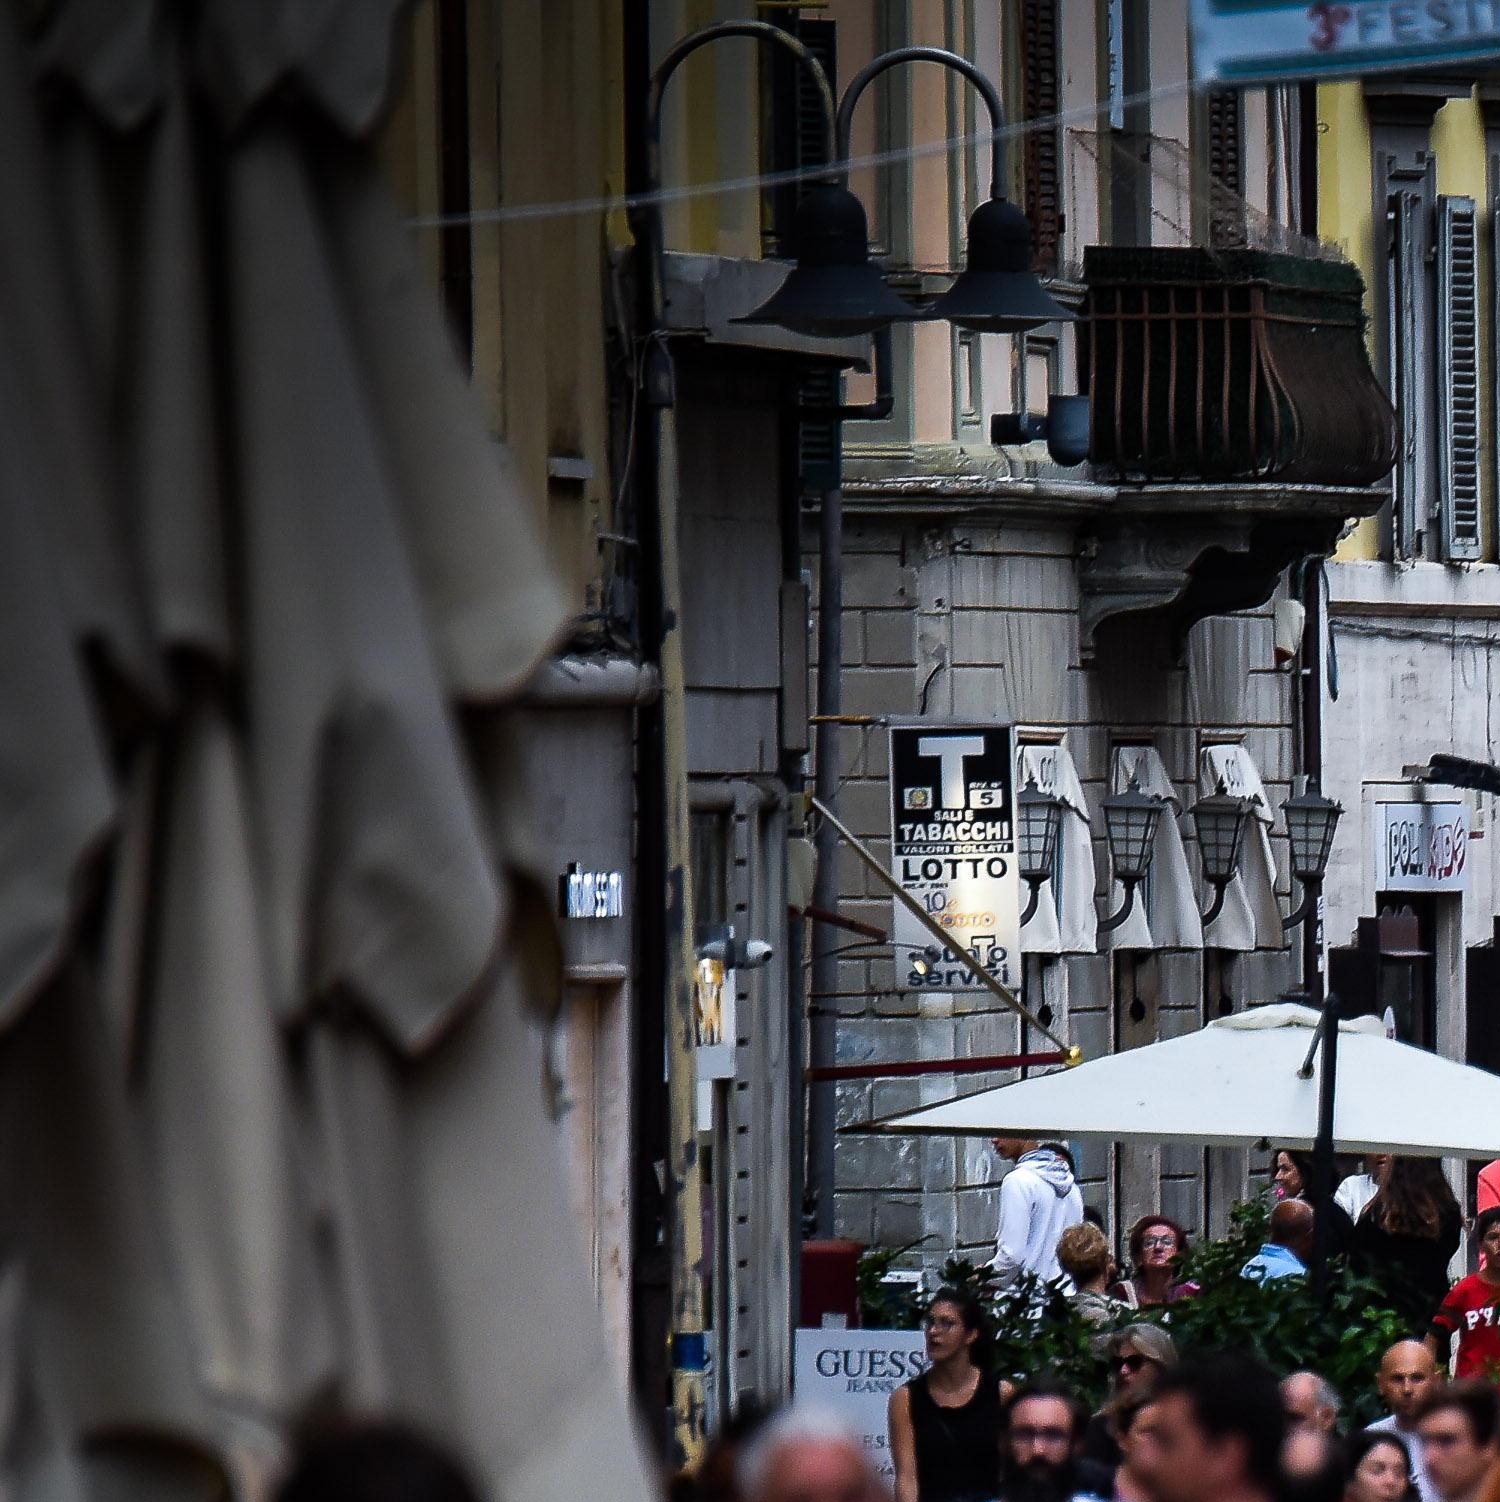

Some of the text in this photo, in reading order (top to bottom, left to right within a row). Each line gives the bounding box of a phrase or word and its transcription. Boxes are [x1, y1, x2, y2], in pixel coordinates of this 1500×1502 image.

[918, 736, 985, 809] T
[980, 792, 994, 806] 5
[933, 809, 975, 822] SALI E
[899, 820, 1009, 842] TABACCHI
[901, 843, 1008, 855] VALORI BOLLATI
[1427, 816, 1466, 881] KIDS
[901, 856, 1008, 882] LOTTO
[815, 1347, 926, 1379] GUESS
